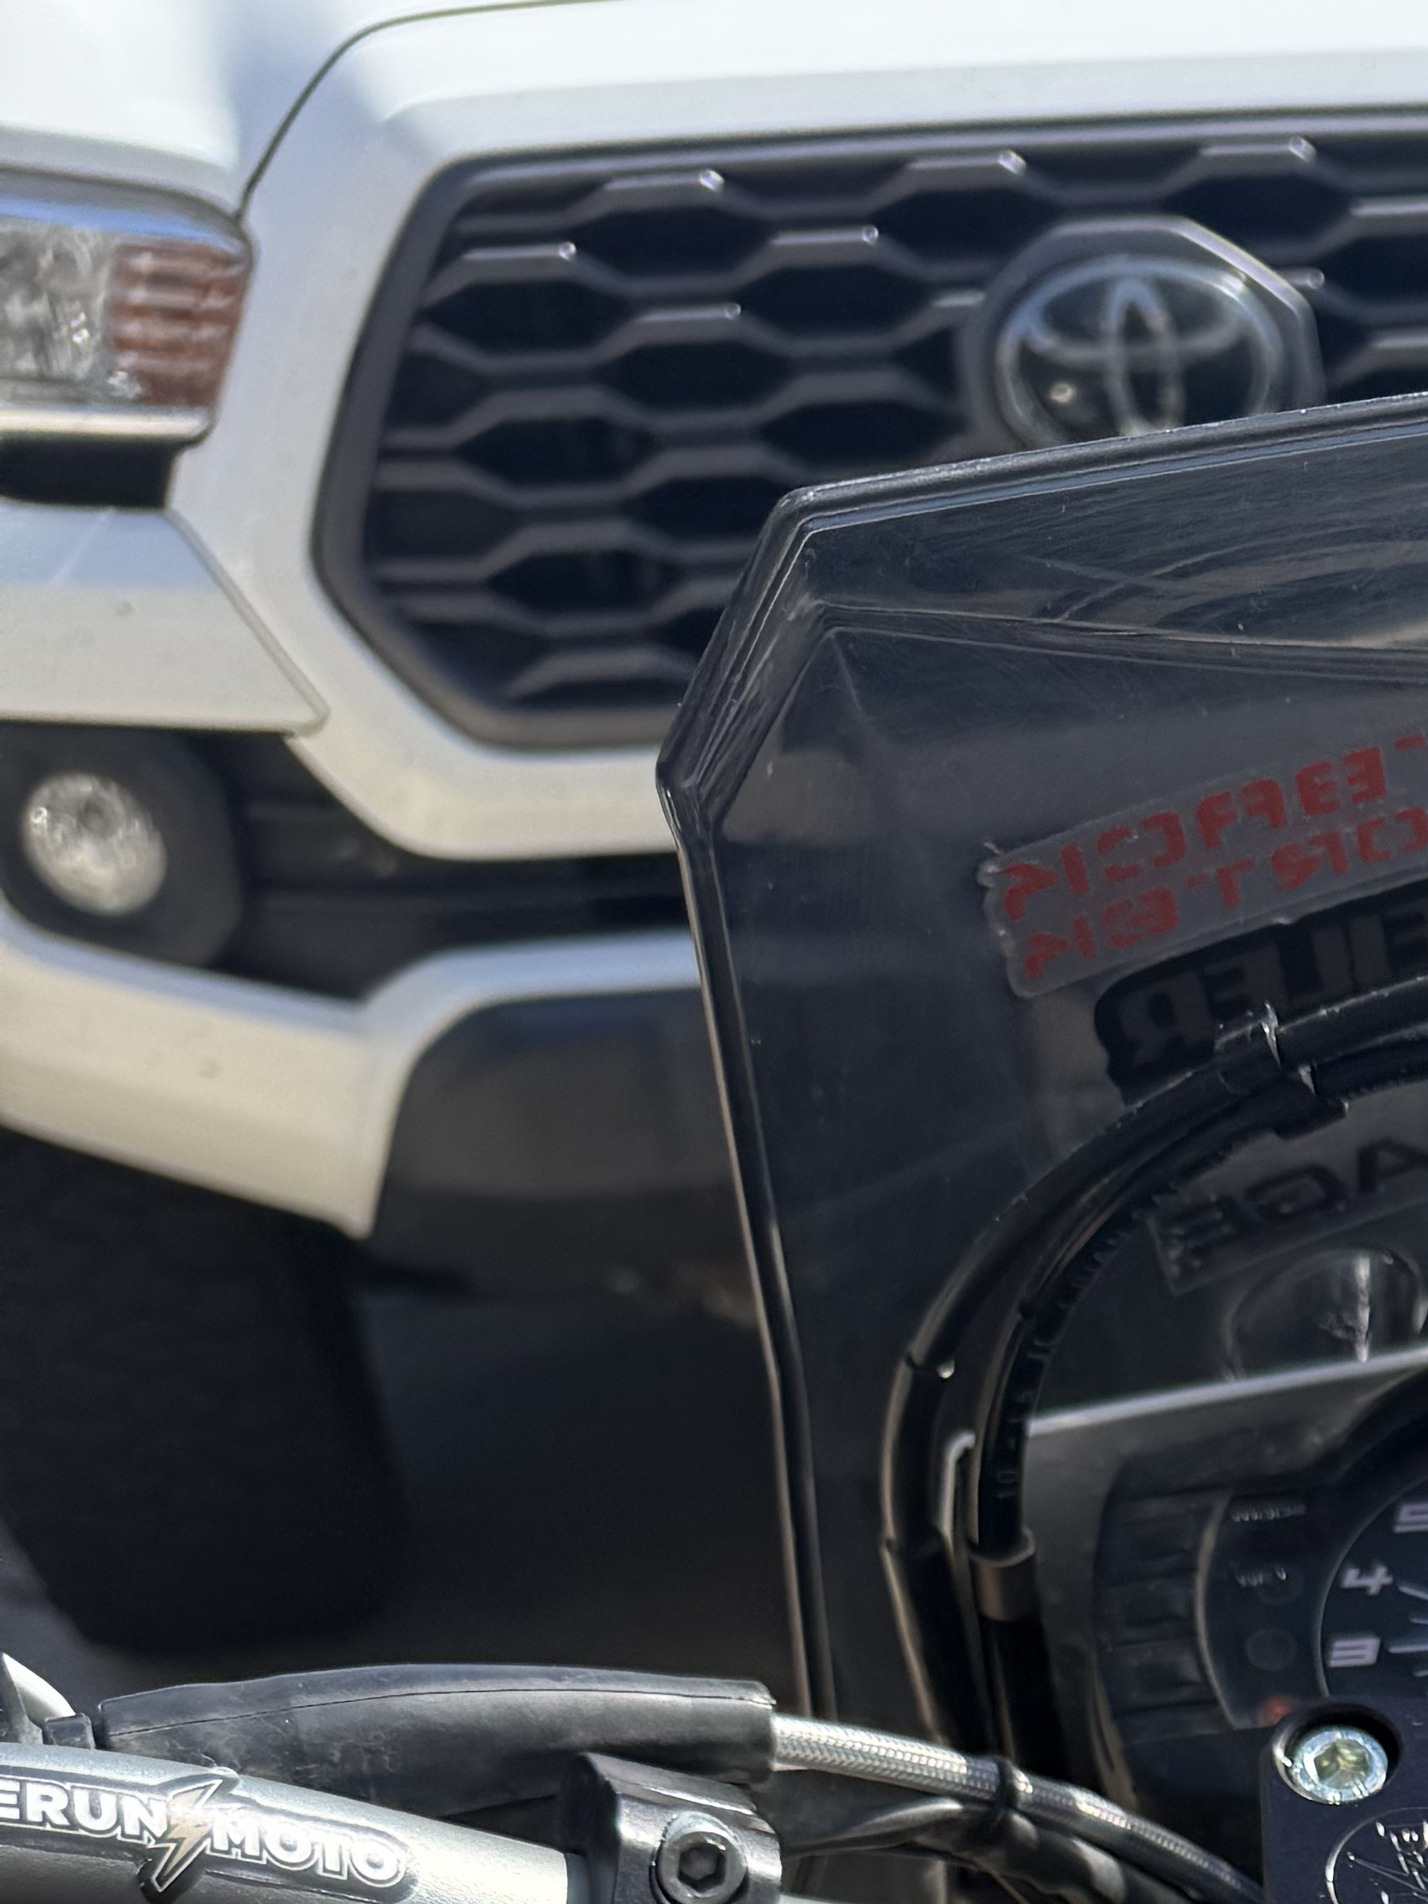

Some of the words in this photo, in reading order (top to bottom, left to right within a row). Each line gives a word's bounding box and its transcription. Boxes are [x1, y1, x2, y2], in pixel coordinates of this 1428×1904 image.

[1340, 1564, 1393, 1598] 4
[1328, 1634, 1381, 1668] 3
[0, 1777, 169, 1838] ERUN
[206, 1808, 403, 1884] MOTO
